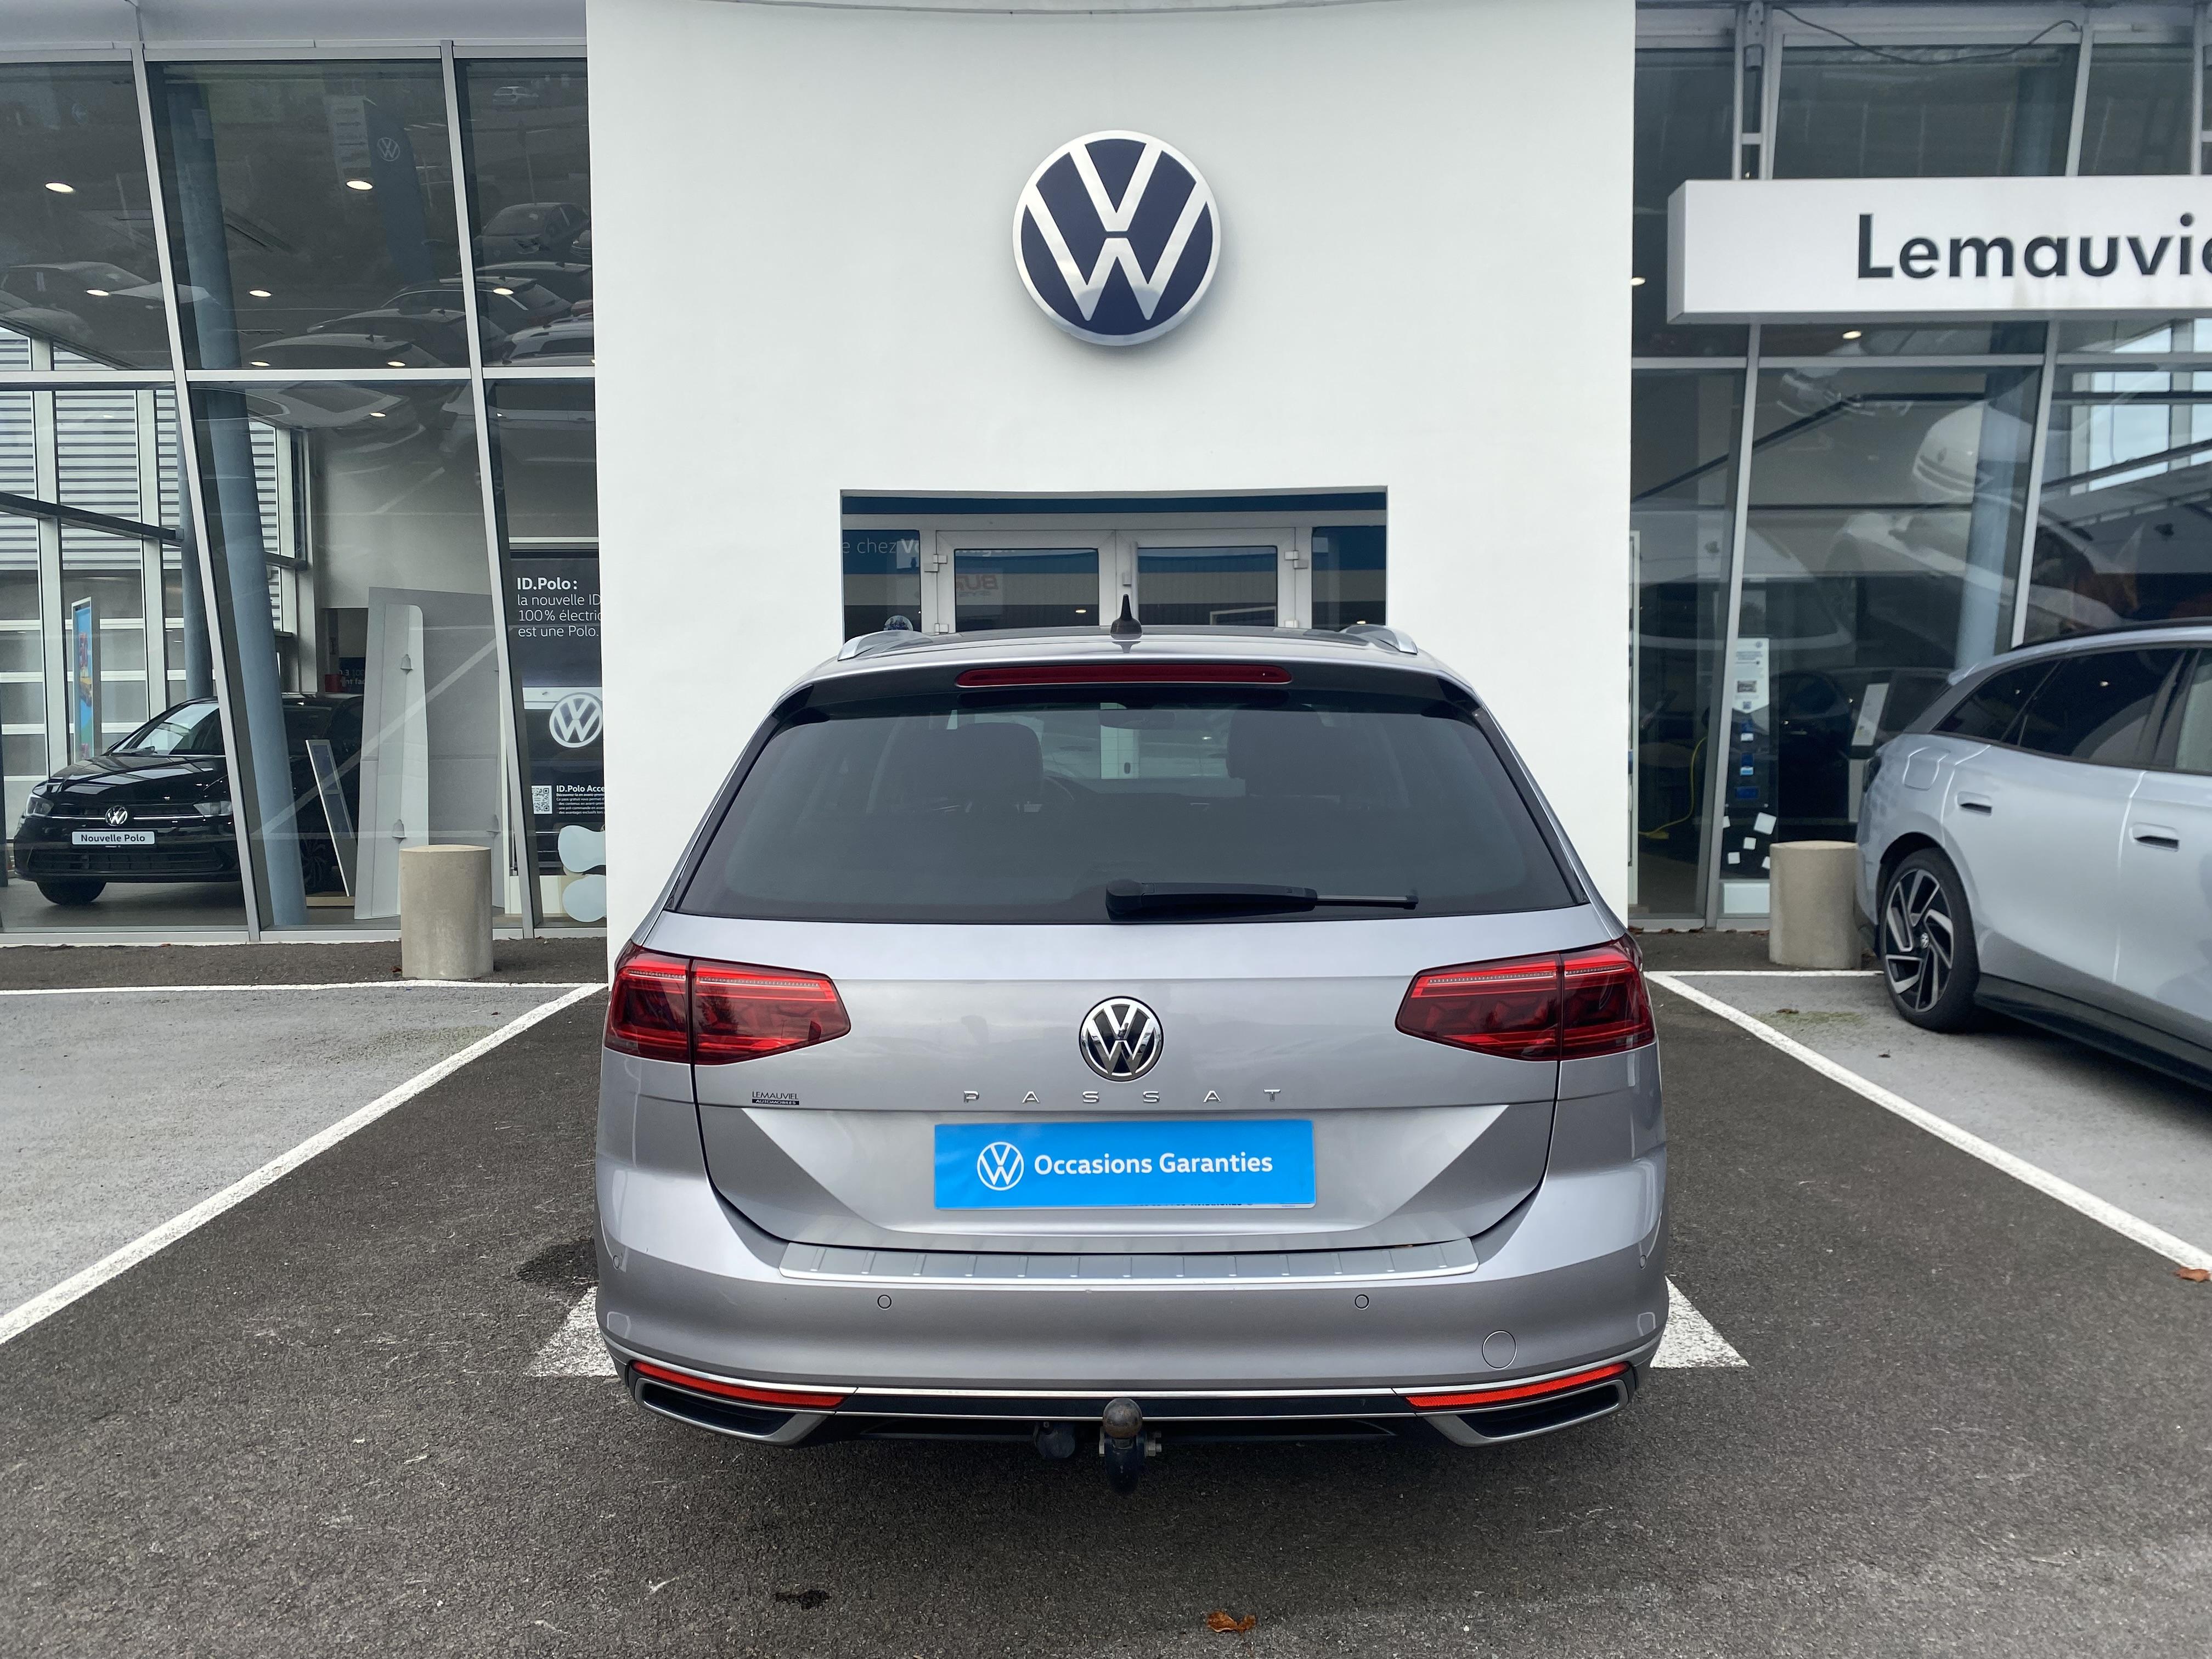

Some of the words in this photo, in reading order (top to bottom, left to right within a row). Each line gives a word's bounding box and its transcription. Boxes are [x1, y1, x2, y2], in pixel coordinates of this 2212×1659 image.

[1858, 212, 2212, 279] Lemauvi
[857, 538, 896, 554] chez
[517, 594, 528, 606] la
[532, 594, 585, 606] nouvelle
[518, 627, 537, 637] est
[540, 627, 564, 637] une
[568, 625, 599, 637] Polo.
[125, 834, 145, 842] Polo
[752, 1091, 799, 1099] LEMAUVIEL
[1034, 1153, 1153, 1175] Occasions
[1159, 1151, 1273, 1173] Garanties
